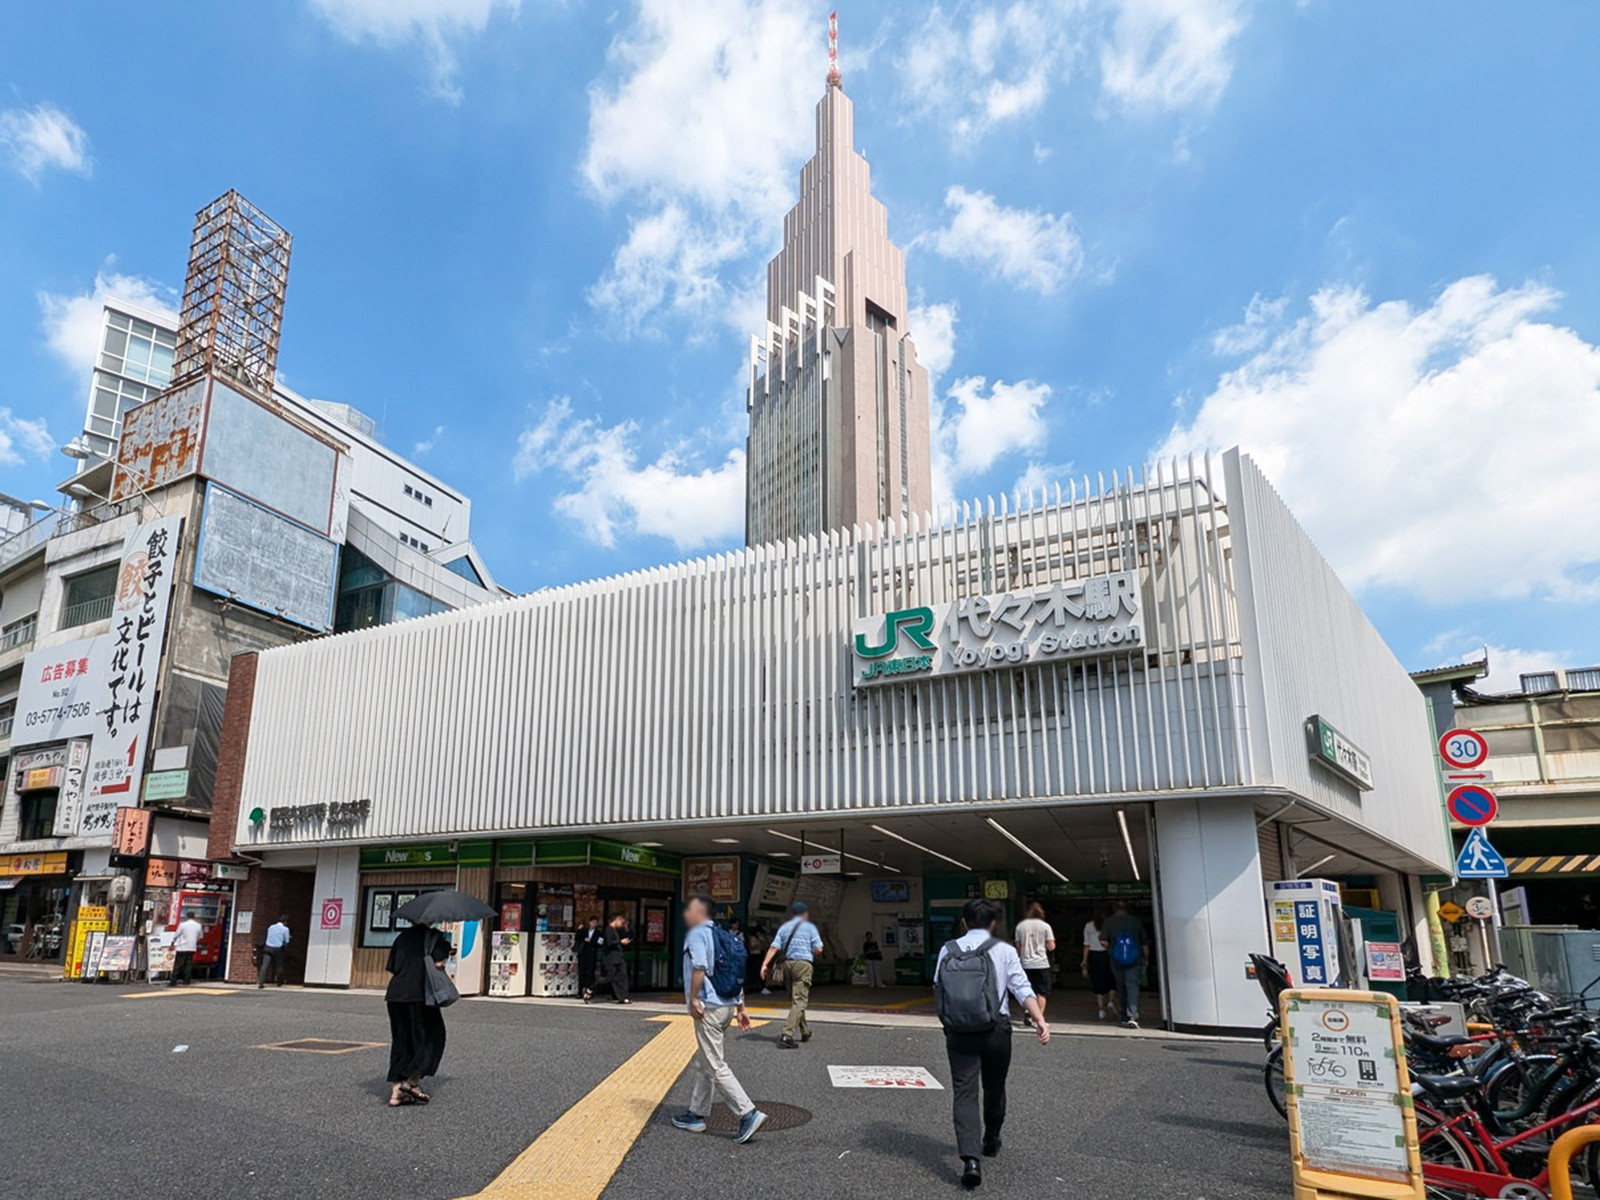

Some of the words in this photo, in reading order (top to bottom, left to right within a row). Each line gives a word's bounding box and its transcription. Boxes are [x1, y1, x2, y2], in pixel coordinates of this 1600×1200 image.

[123, 528, 168, 724] 餃子とビールは
[947, 571, 1139, 644] 代々木駅
[855, 606, 938, 657] JR
[950, 639, 1030, 667] Yoyogi
[1040, 623, 1142, 654] Station
[40, 657, 88, 683] 広告募集
[102, 616, 134, 738] 文化です。
[861, 655, 933, 679] JR東日本
[25, 701, 91, 726] 03-5774-7506
[1450, 740, 1478, 758] 30
[1298, 904, 1323, 980] 証明写真
